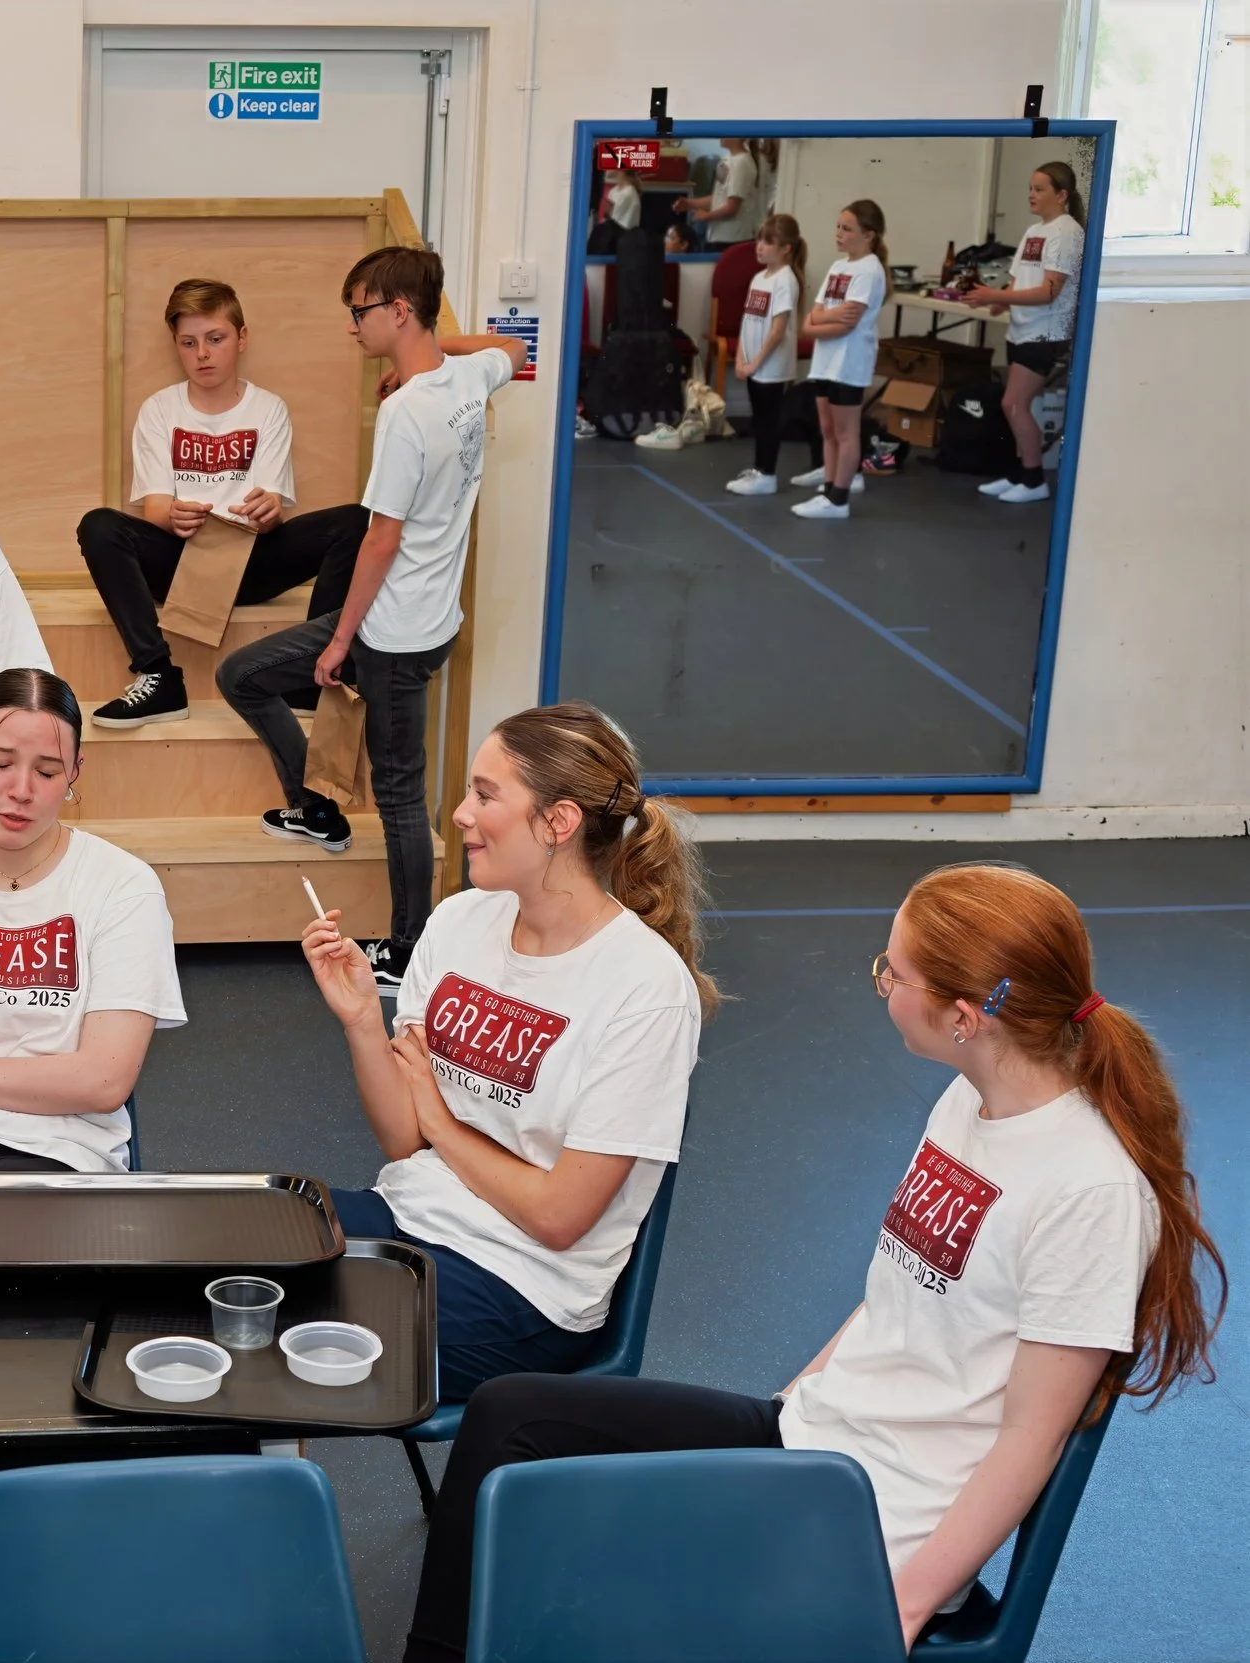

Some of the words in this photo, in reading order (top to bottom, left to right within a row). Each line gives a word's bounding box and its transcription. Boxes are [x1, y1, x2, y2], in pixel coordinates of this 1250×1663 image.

[242, 66, 277, 84] Fire
[280, 67, 318, 84] exit
[240, 99, 277, 116] Keep
[280, 99, 316, 112] clear
[638, 144, 648, 152] NO
[180, 439, 252, 464] GREASE
[174, 472, 225, 483] DOSYTCo
[0, 927, 47, 941] TOGETHER
[58, 974, 68, 984] 59
[27, 990, 71, 1007] 2025
[468, 989, 483, 1002] WE
[484, 997, 499, 1009] GO
[500, 1002, 541, 1025] TOGETHER
[433, 997, 551, 1067] GREASE
[441, 1041, 458, 1058] THE
[464, 1053, 508, 1078] MUSICAL
[513, 1071, 525, 1083] 59
[431, 1058, 481, 1095] OSYTCo
[488, 1083, 522, 1109] 2025
[935, 1160, 948, 1174] GO
[946, 1168, 976, 1194] TOGETHER
[878, 1233, 914, 1273] OSYTCo
[904, 1222, 933, 1255] MUSICAL
[939, 1252, 953, 1267] 59
